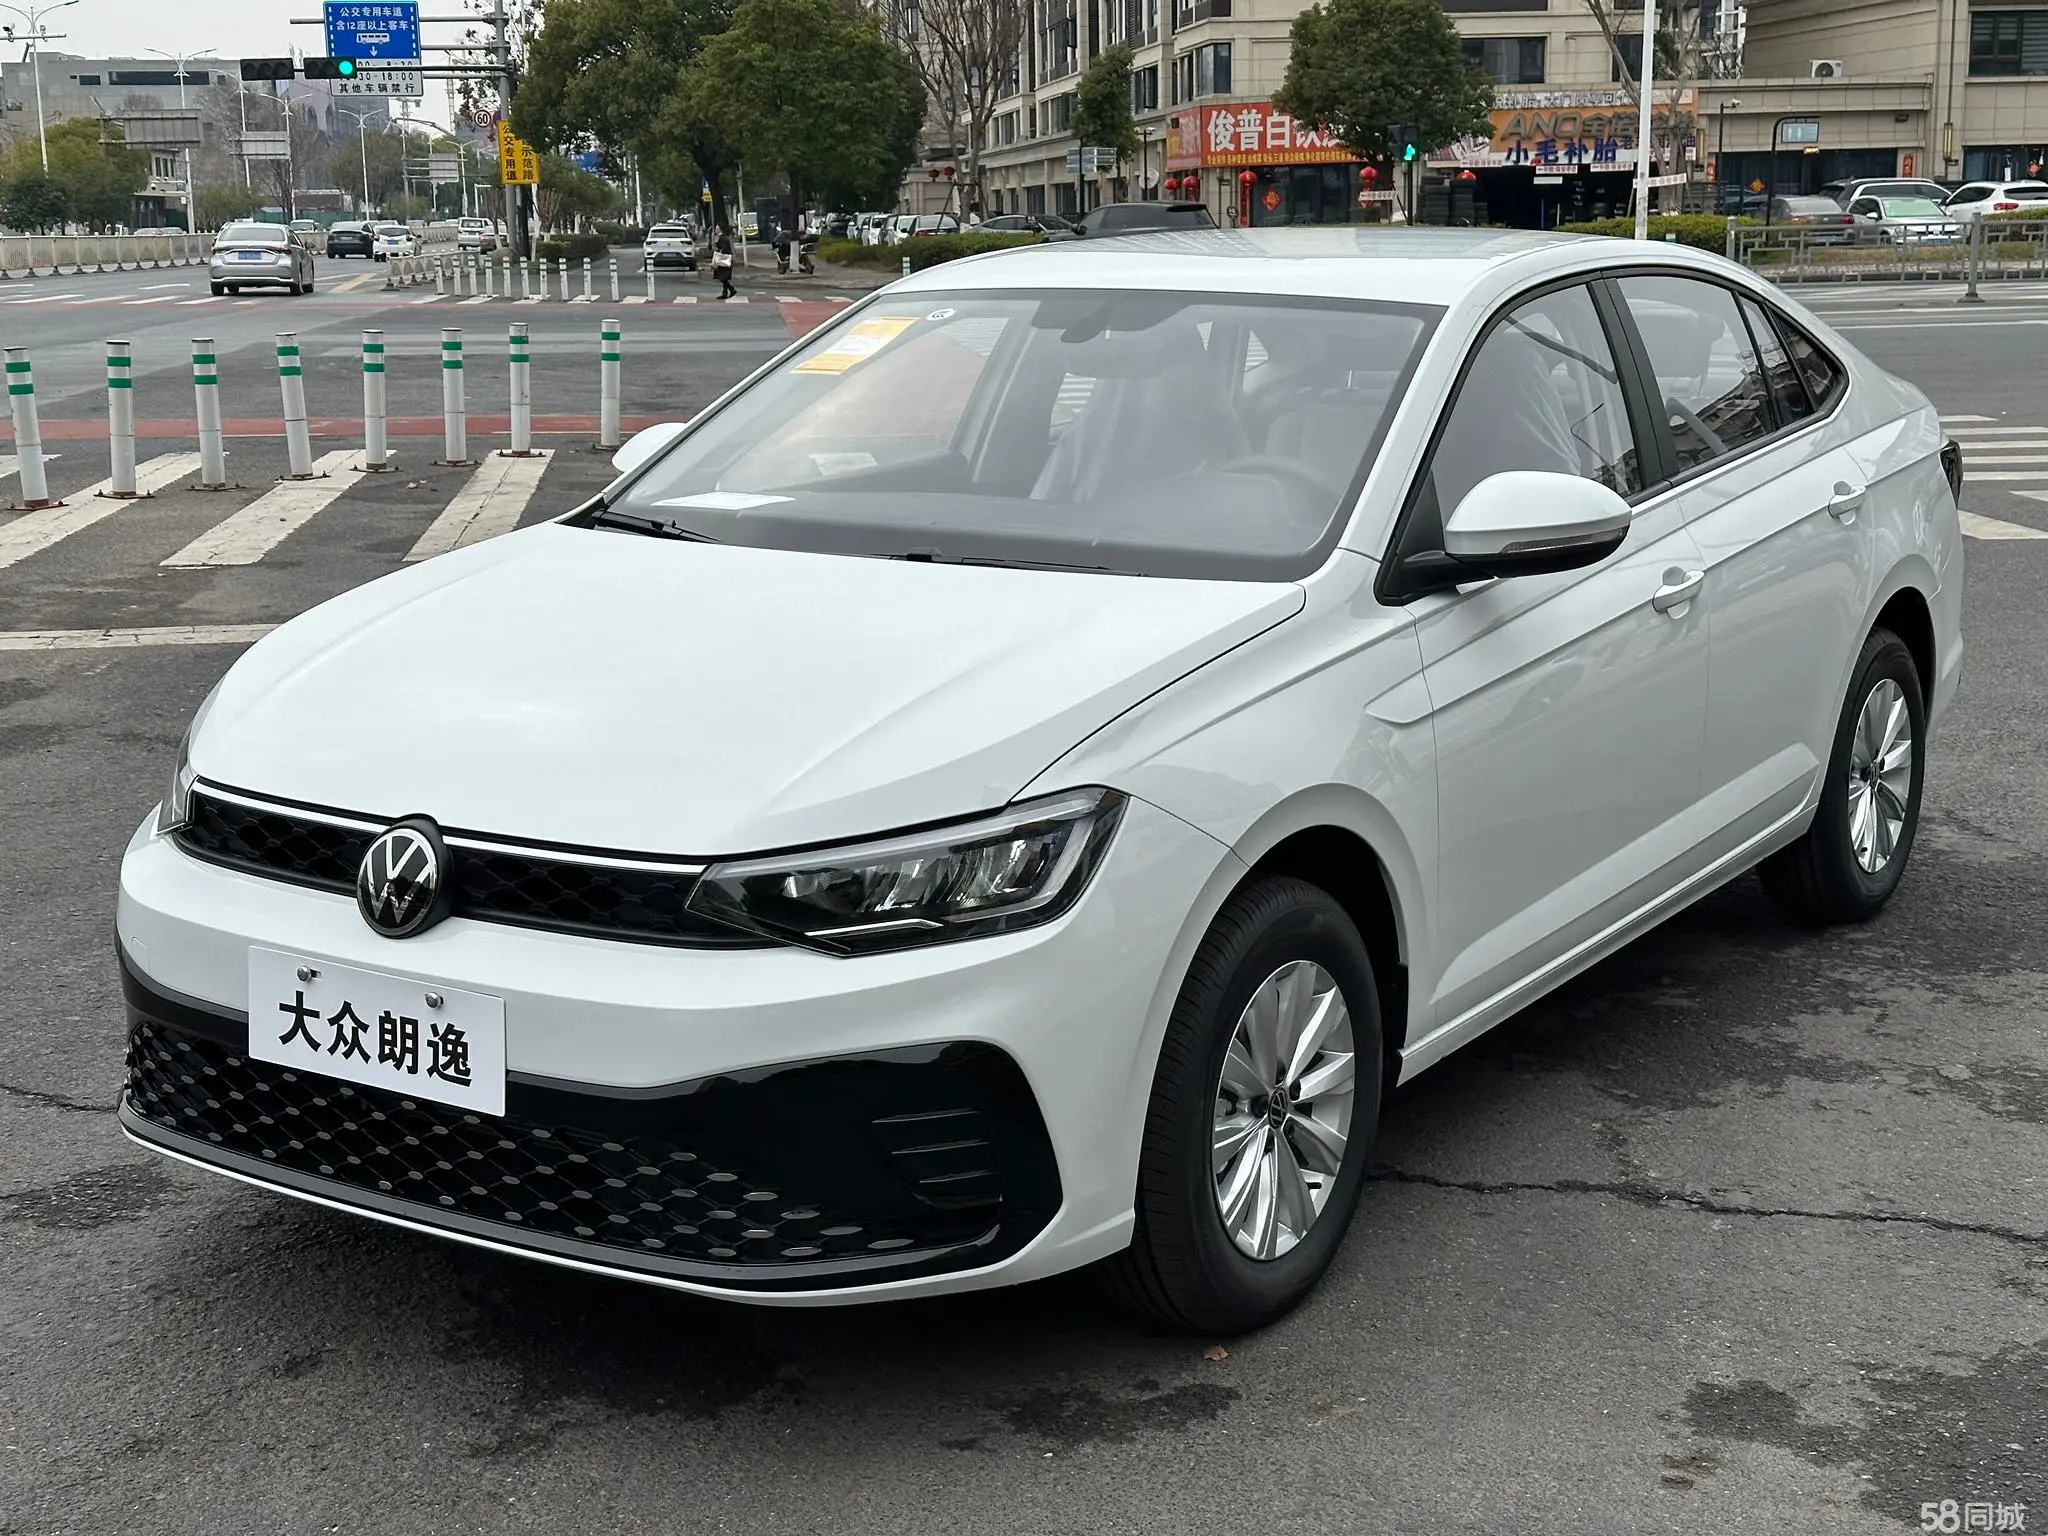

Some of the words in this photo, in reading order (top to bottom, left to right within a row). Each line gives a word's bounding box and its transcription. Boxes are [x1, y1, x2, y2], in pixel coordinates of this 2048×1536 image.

[340, 6, 403, 17] 公交专用车道
[336, 20, 409, 31] 含12座以上客车
[339, 83, 414, 93] 其他车辆禁行
[477, 113, 488, 124] 60
[504, 125, 517, 180] 公交专用道
[1505, 136, 1617, 165] 小毛补胎
[278, 990, 472, 1087] 大众朗逸
